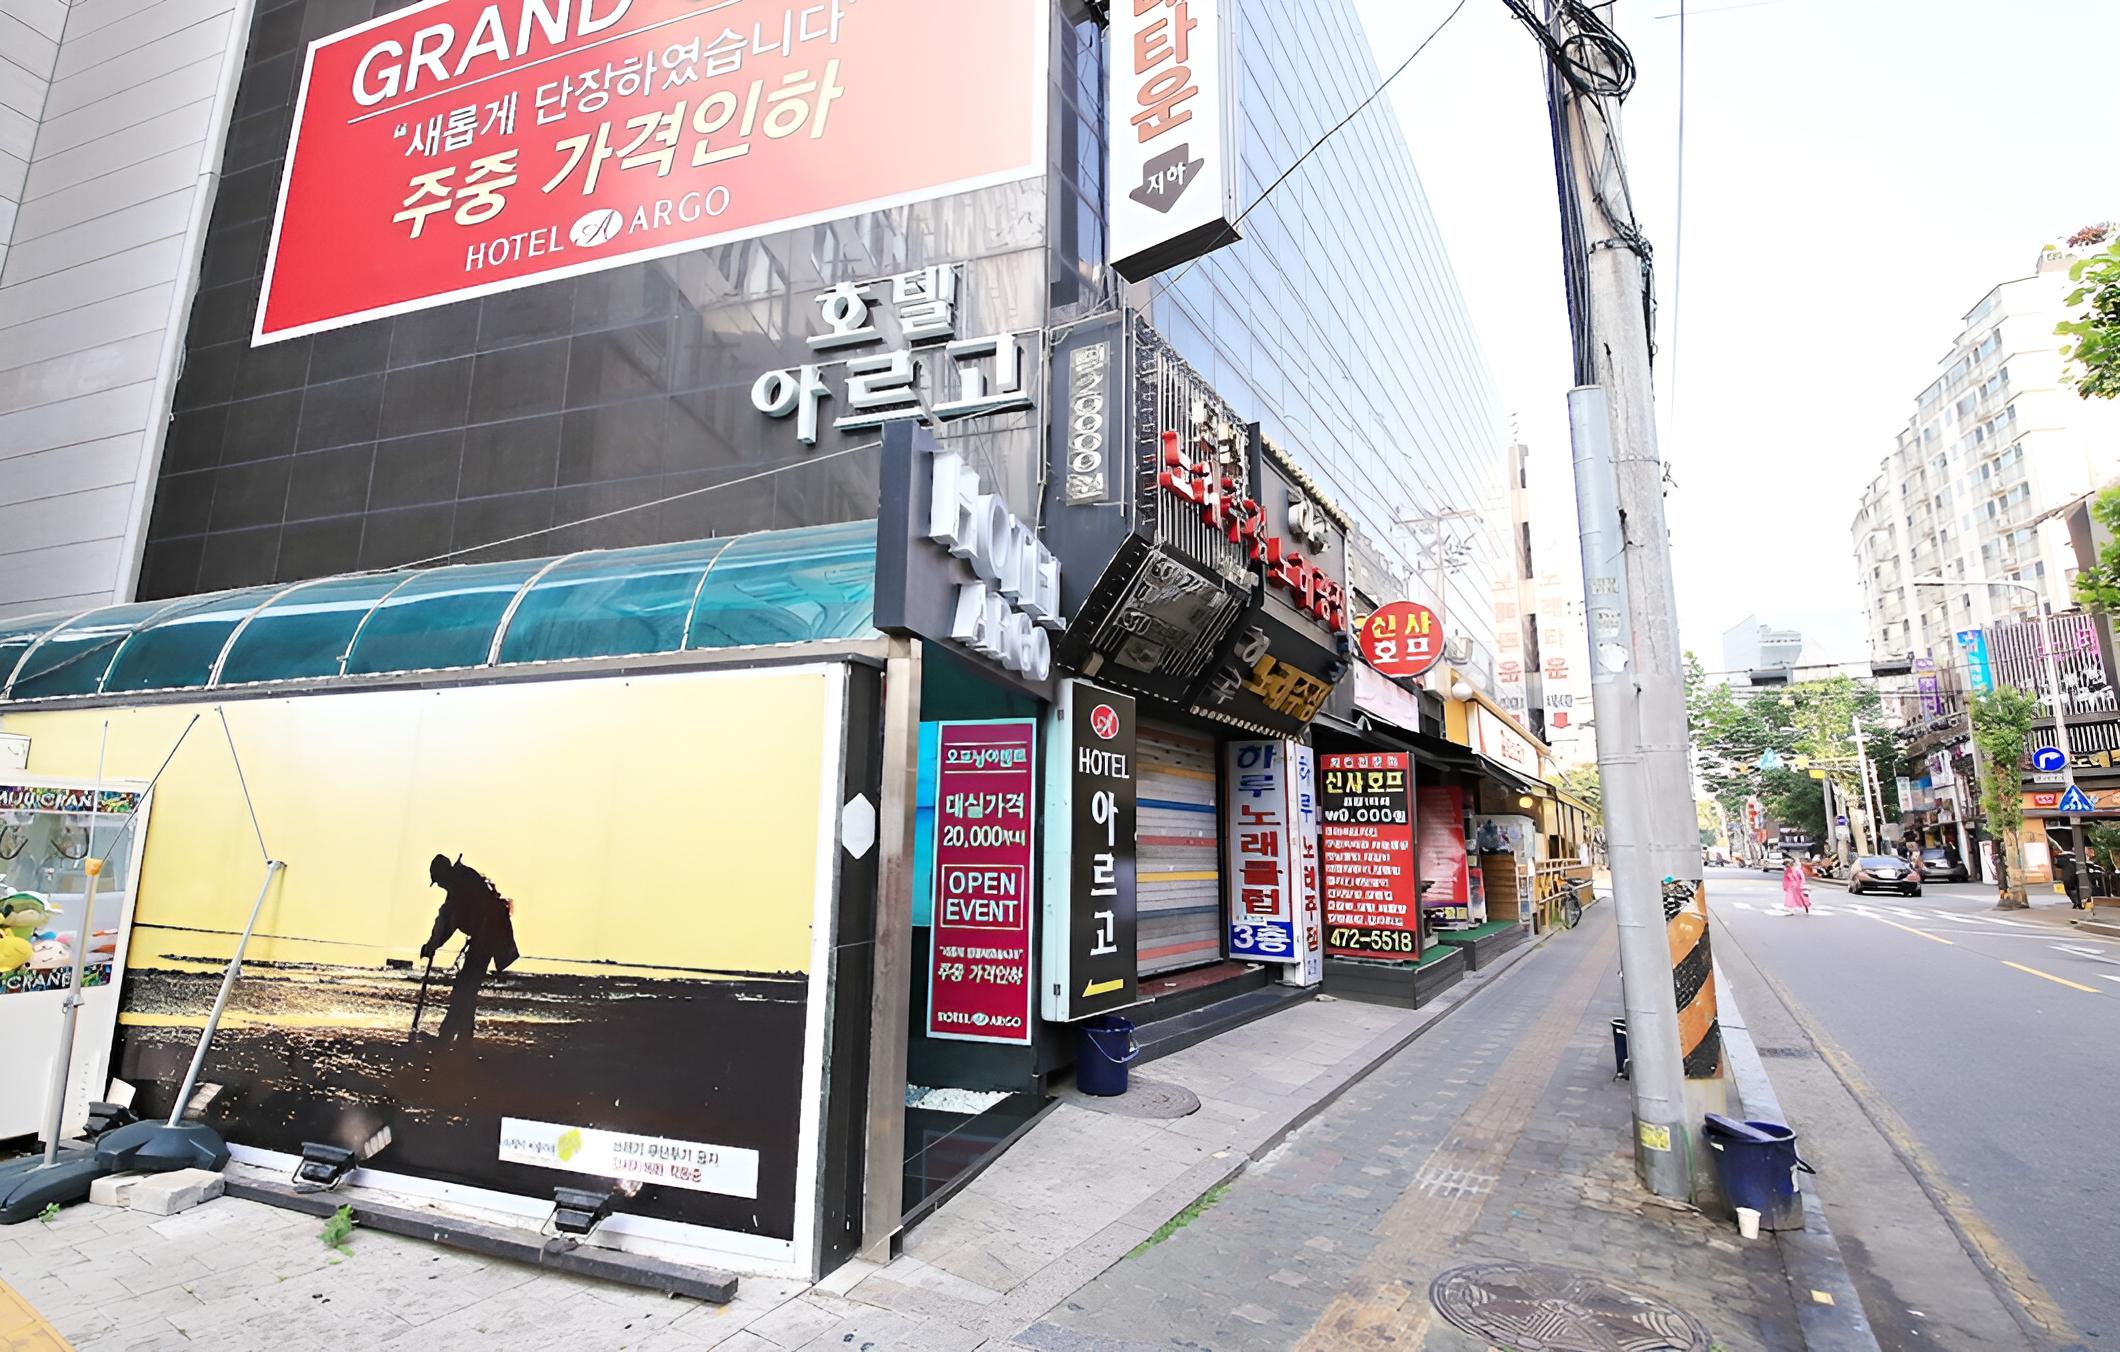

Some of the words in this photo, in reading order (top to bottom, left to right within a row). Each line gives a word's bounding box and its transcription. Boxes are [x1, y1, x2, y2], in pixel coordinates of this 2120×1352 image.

[351, 0, 635, 107] GRAND
[1130, 0, 1199, 144] 타운
[393, 148, 519, 240] 주중
[541, 58, 845, 196] 가격인하
[465, 225, 565, 272] HOTEL
[628, 185, 731, 234] ARGO
[806, 264, 956, 347] 호텔
[751, 332, 1031, 445] 아르고
[1372, 611, 1432, 639] 신사
[1373, 637, 1432, 664] 호프
[1079, 746, 1130, 780] HOTEL
[946, 899, 1018, 923] EVENT
[949, 871, 1016, 896] OPEN
[1090, 790, 1119, 956] 아르고
